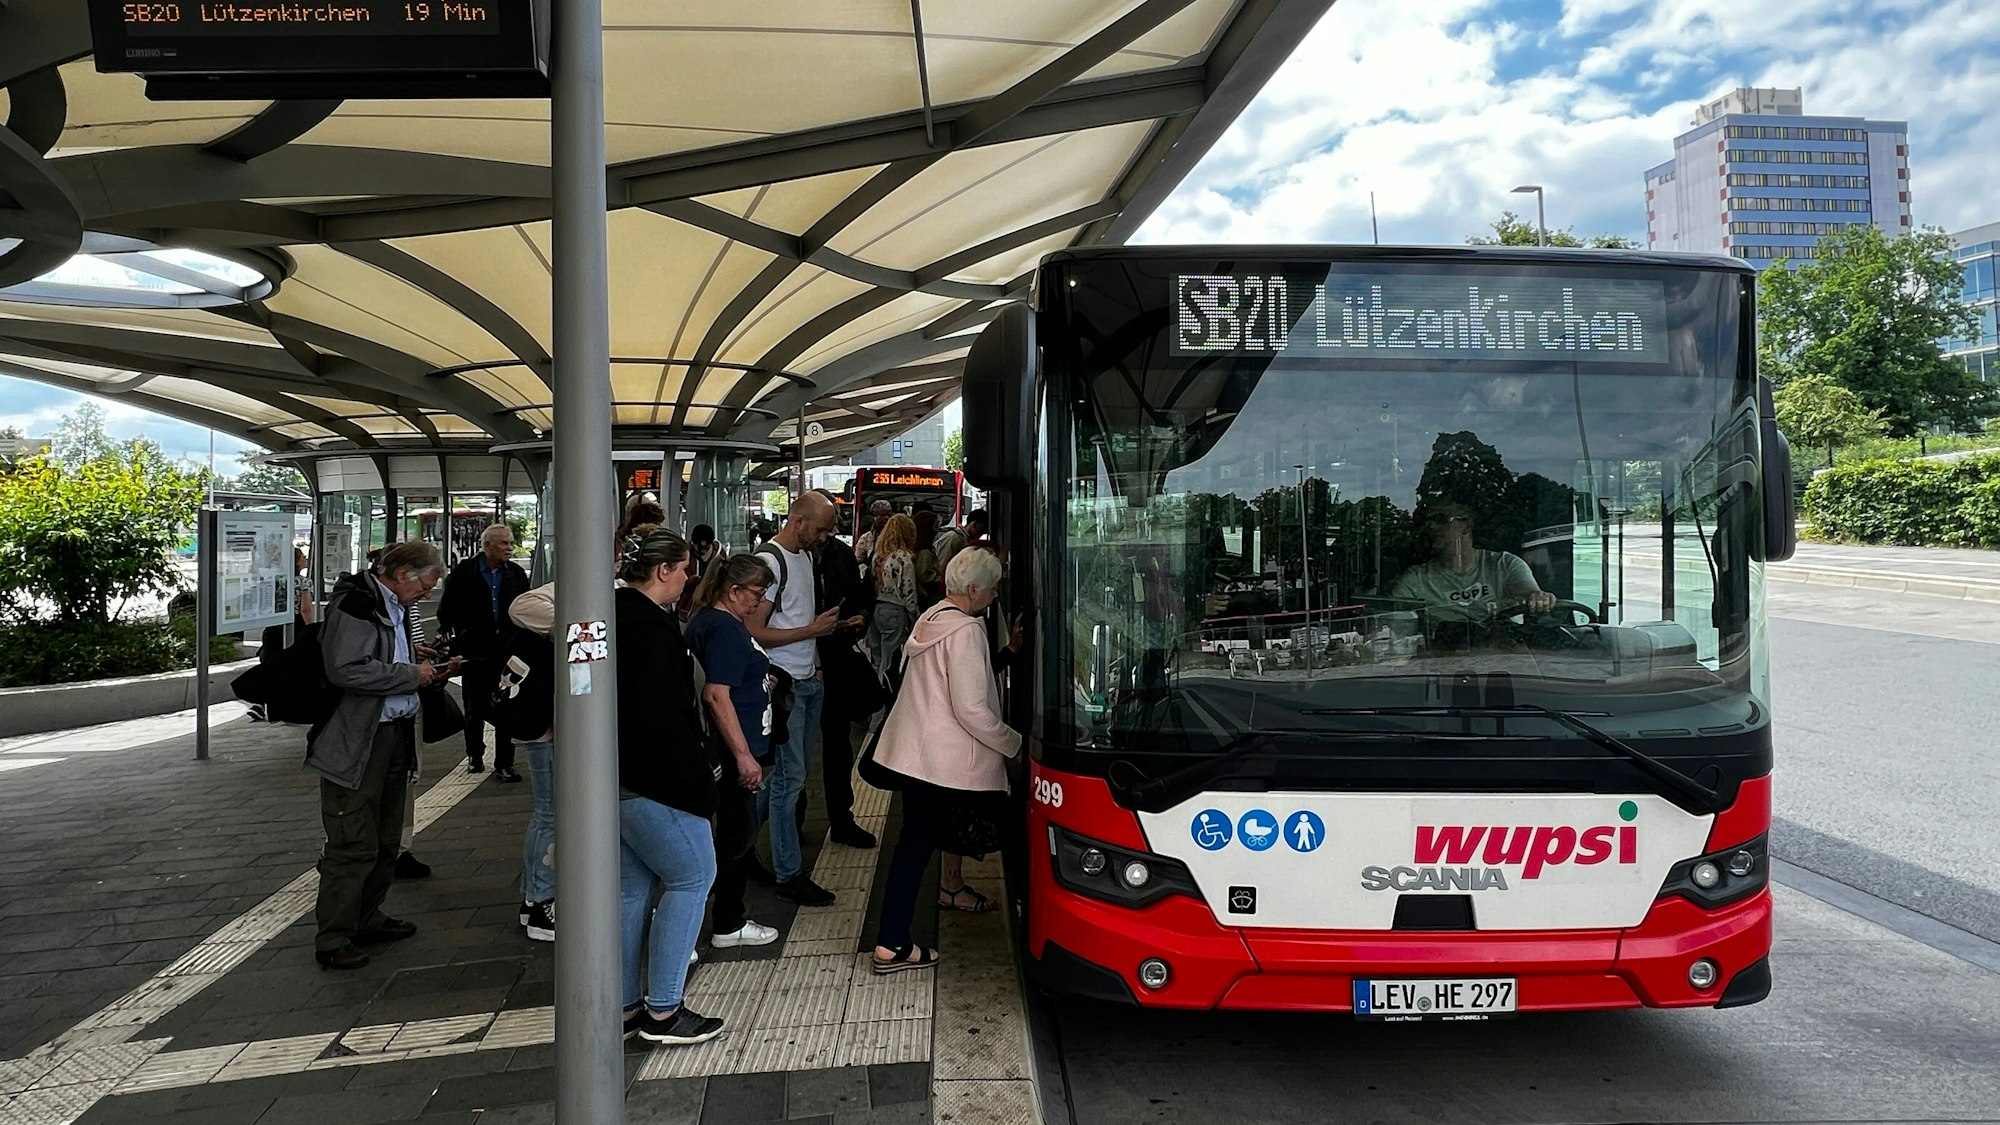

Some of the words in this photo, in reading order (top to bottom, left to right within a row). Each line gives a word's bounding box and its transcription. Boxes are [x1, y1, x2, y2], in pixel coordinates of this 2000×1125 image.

[123, 4, 180, 22] SB20
[201, 4, 370, 22] Lützenkirchen
[404, 3, 430, 21] 19
[443, 3, 486, 21] Min
[1178, 275, 1288, 351] SB20
[1315, 284, 1643, 351] Lützenkirchen
[811, 425, 819, 436] 8
[1034, 775, 1064, 808] 299
[1413, 800, 1638, 879] wupsi
[1361, 866, 1509, 891] SCANIA
[1371, 984, 1416, 1010] LEV
[1434, 983, 1464, 1009] HE
[1471, 982, 1513, 1008] 297
